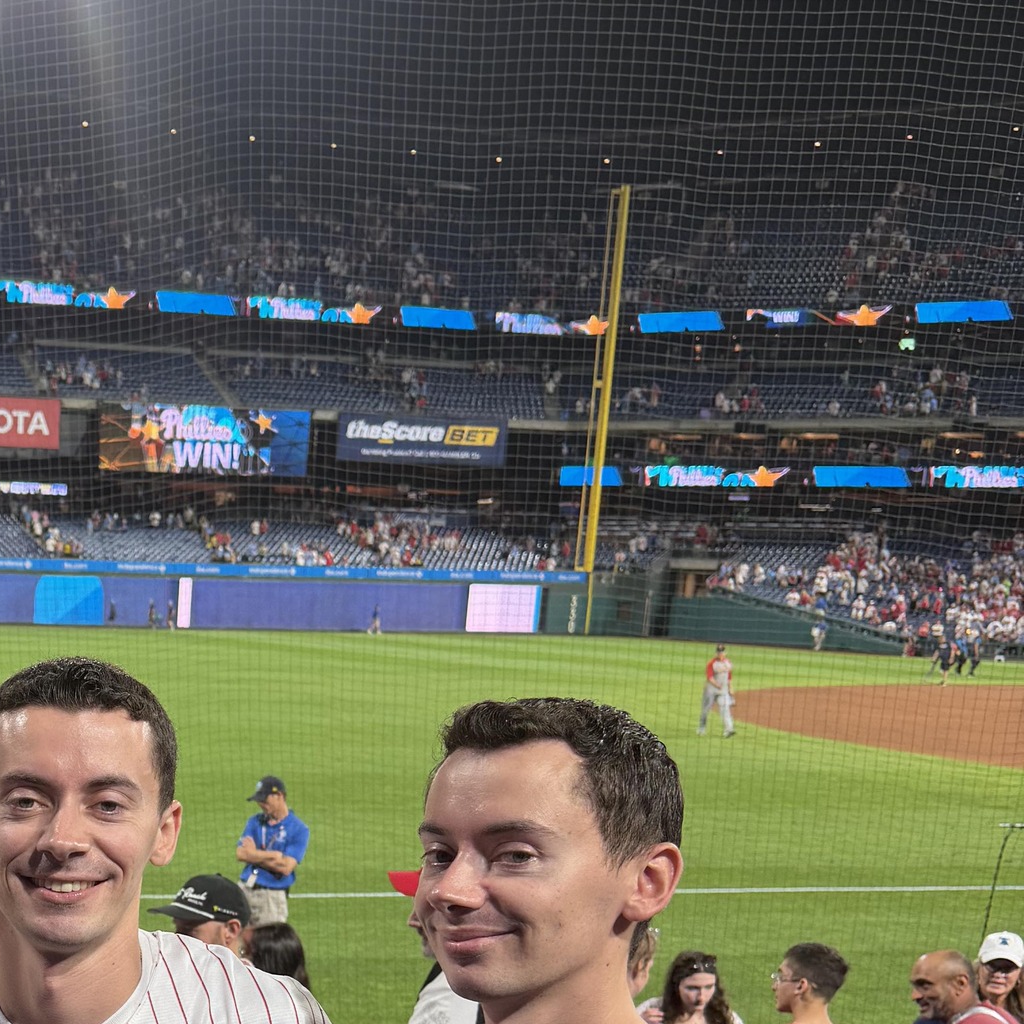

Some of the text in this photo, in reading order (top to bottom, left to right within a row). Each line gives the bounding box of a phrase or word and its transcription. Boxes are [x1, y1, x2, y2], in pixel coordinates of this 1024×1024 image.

[160, 407, 233, 440] Phillies
[346, 419, 495, 444] theScore BET
[173, 441, 241, 469] WIN!
